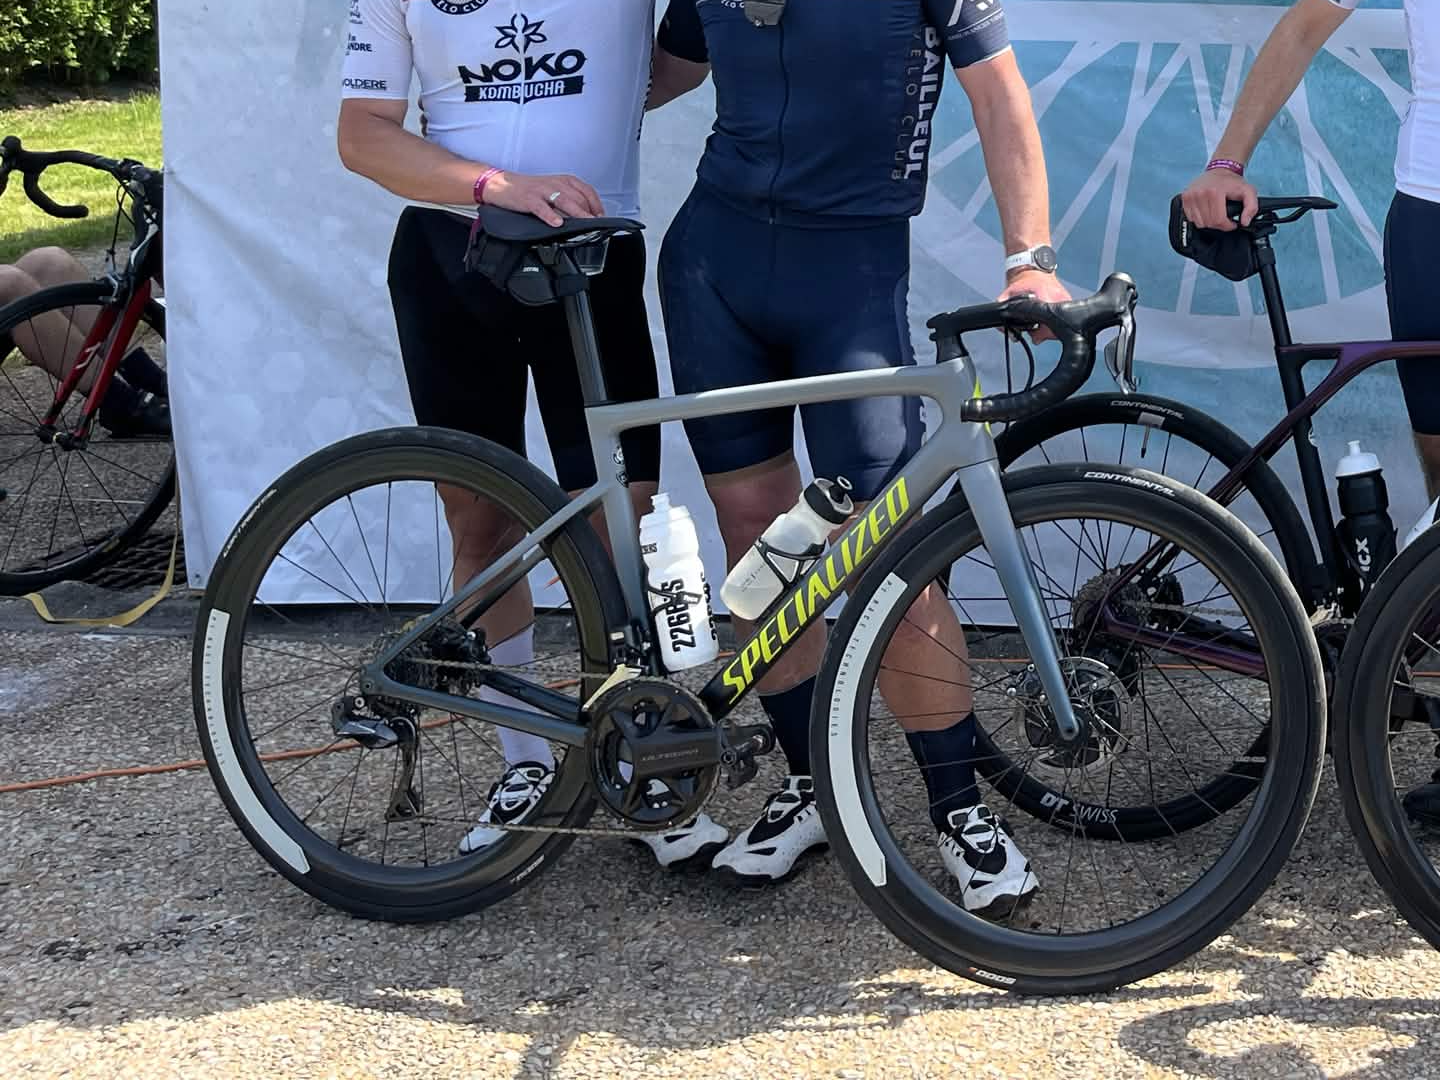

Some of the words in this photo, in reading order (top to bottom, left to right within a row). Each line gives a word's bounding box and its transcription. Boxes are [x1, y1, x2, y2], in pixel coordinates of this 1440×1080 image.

[457, 48, 588, 85] NOKO
[479, 79, 565, 101] KOMBUCHA
[902, 25, 942, 181] BAILLEUL
[1109, 399, 1185, 420] CONTINENTAL
[1083, 471, 1176, 497] CONTINENTAL
[722, 475, 910, 705] SPECIALIZED
[1039, 791, 1070, 811] DT
[1072, 804, 1119, 824] SWISS
